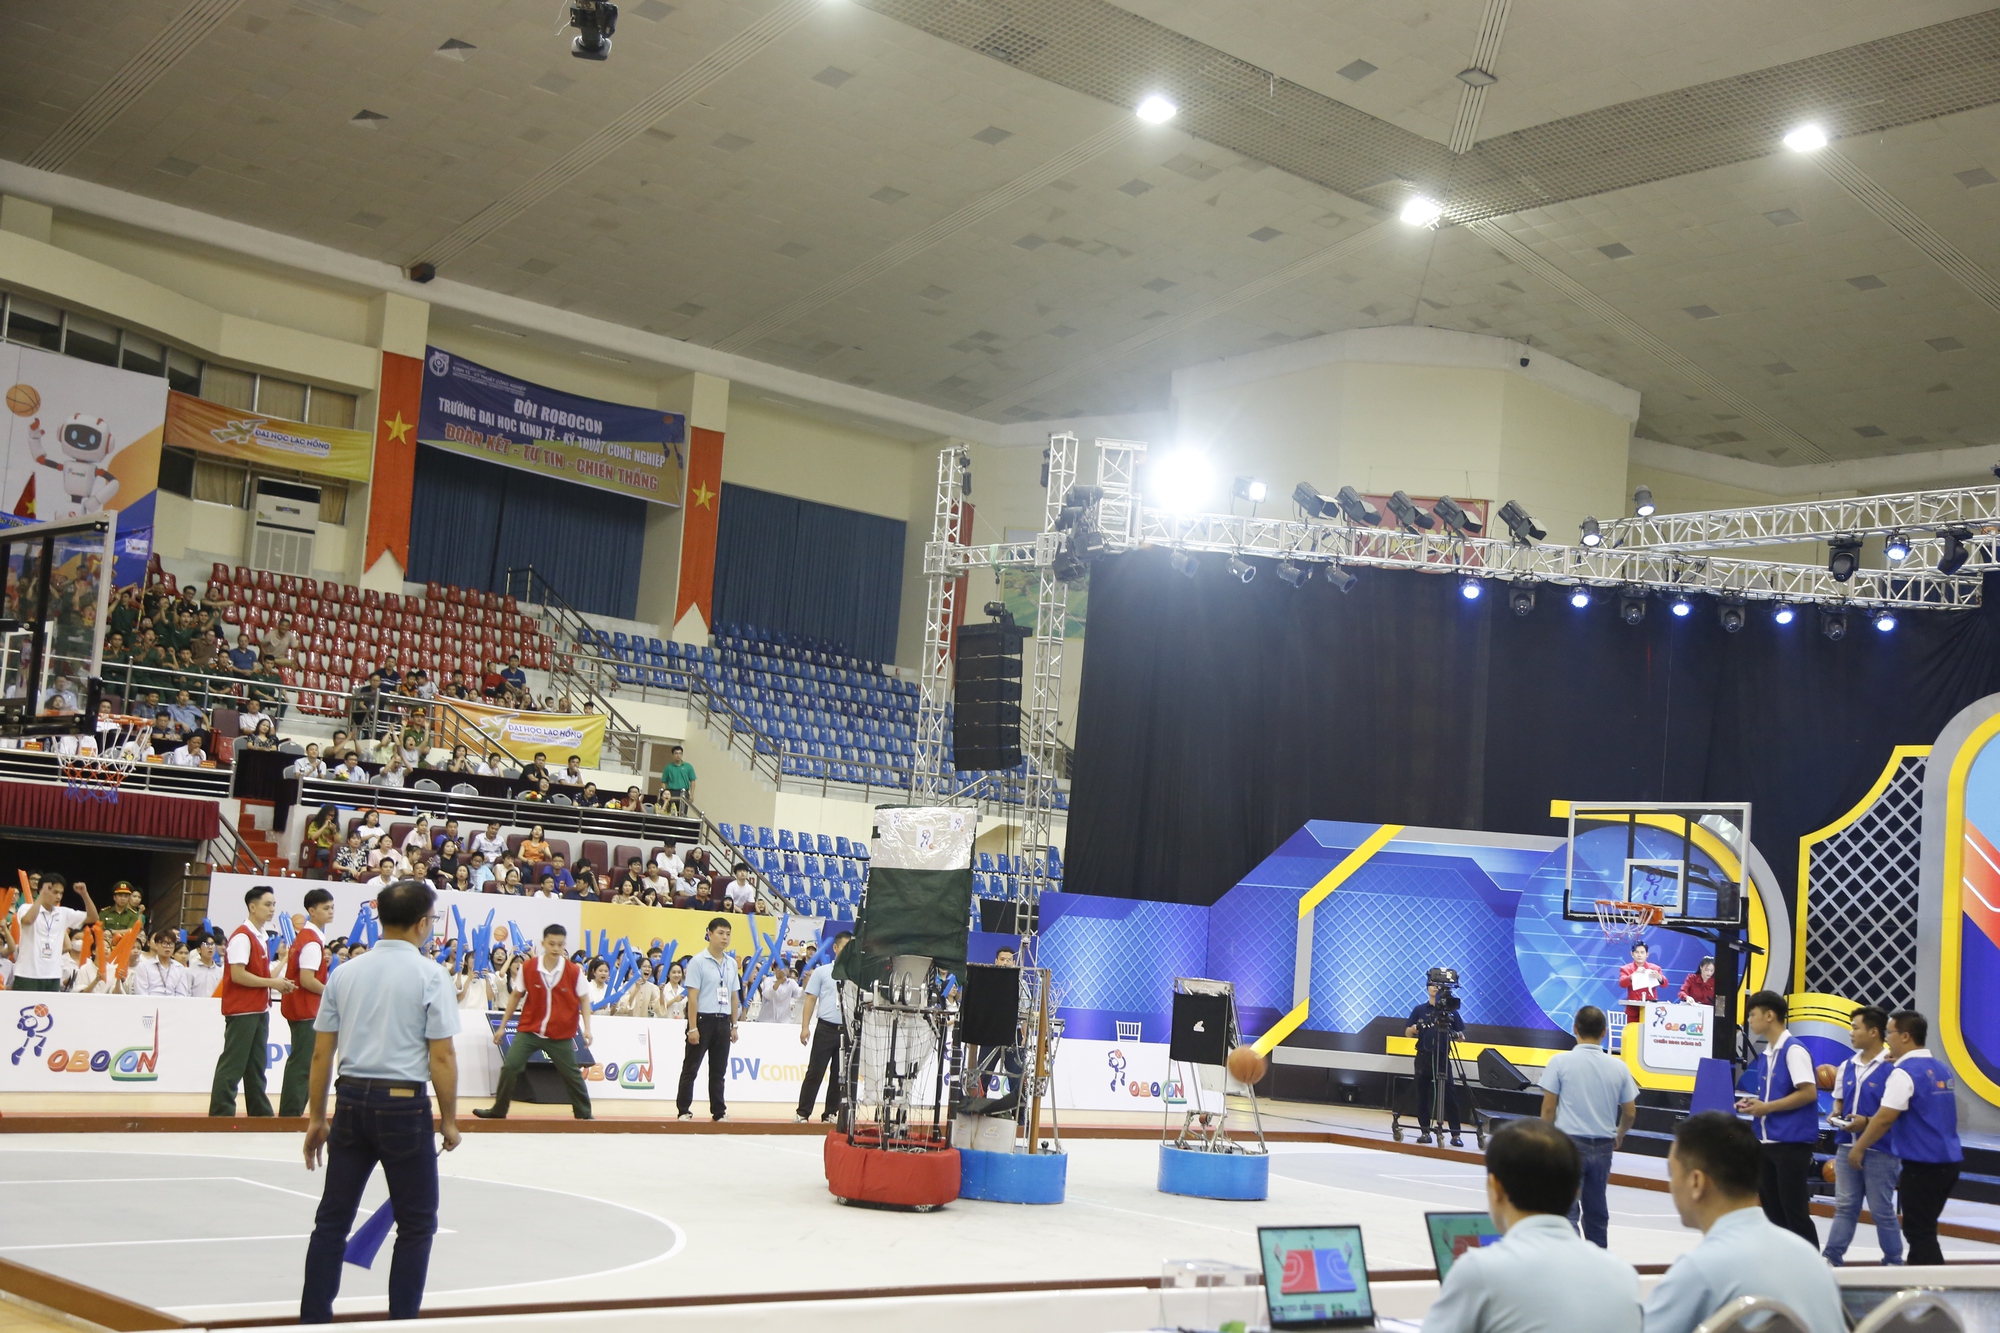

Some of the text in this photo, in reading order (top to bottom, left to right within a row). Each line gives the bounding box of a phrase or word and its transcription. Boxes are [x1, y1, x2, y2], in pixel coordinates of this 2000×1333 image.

[514, 398, 603, 435] ĐỘI ROBOCON
[255, 429, 269, 439] ĐẠI
[271, 432, 288, 442] HỌC
[306, 437, 330, 451] HỒNG
[439, 396, 477, 421] TRƯỜNG
[478, 409, 495, 427] ĐẠI
[497, 415, 517, 432] HỌC
[520, 421, 542, 439] KINH
[544, 425, 556, 441] TẾ
[563, 432, 575, 447] KỸ
[577, 436, 607, 456] THUẬT
[607, 443, 632, 460] CÔNG
[634, 449, 666, 469] NGHIỆP
[445, 422, 483, 447] ĐOÀN
[486, 432, 512, 456] KẾT
[523, 443, 542, 465] TỰ
[543, 449, 565, 469] TIN
[576, 457, 614, 480] CHIẾN
[617, 467, 659, 492] THẮNG
[508, 724, 522, 733] ĐẠI
[524, 726, 542, 736] HỌC
[559, 727, 582, 739] HỒNG
[302, 845, 309, 860] C
